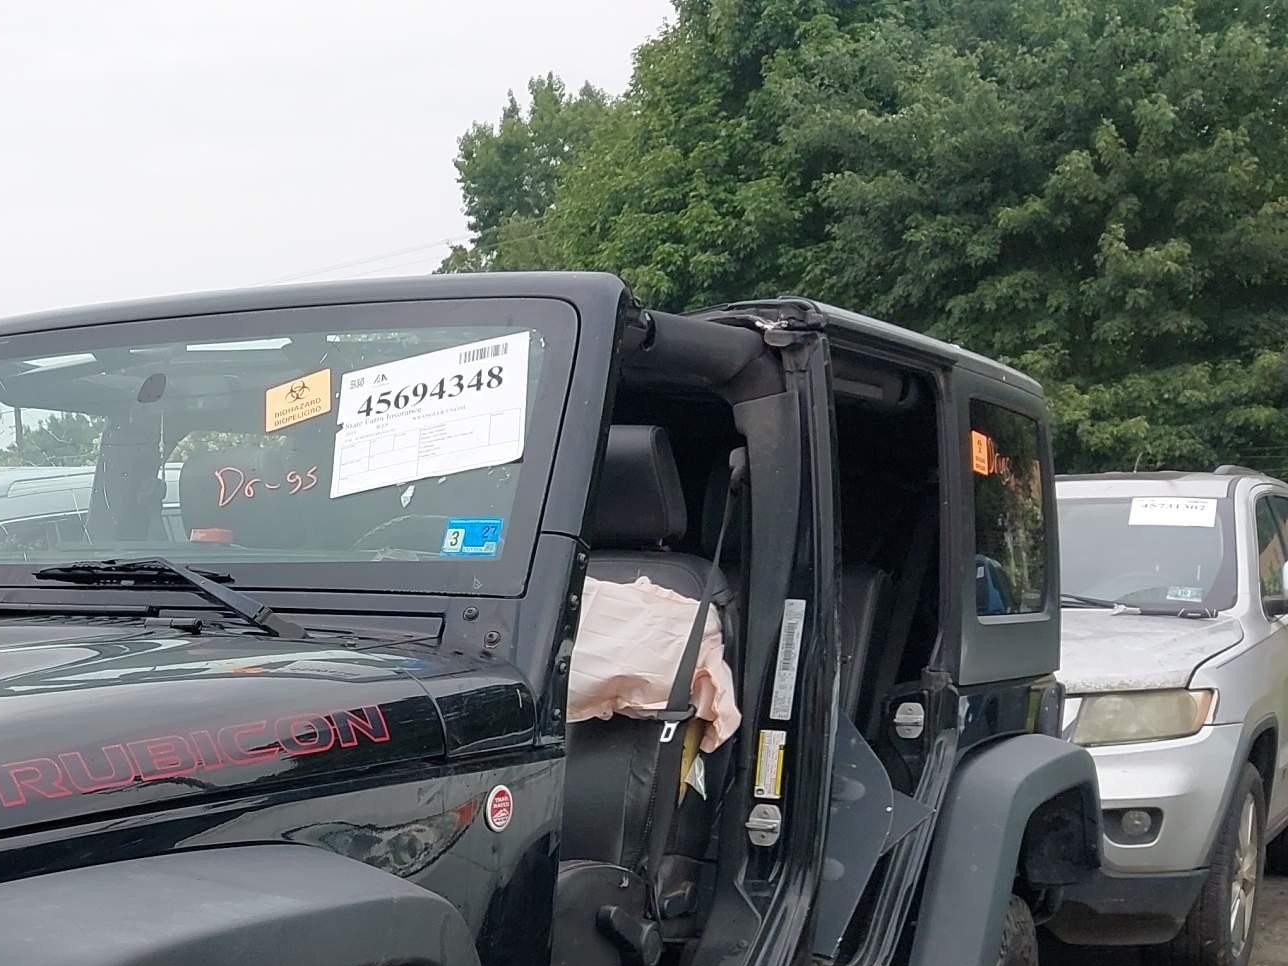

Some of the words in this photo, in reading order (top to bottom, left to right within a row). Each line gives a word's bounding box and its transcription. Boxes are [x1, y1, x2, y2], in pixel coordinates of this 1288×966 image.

[357, 365, 504, 417] 45694348
[274, 397, 321, 419] BIOHAZARD
[274, 406, 322, 427] BIOPELIGRO
[450, 530, 460, 547] 3
[482, 525, 499, 539] 27
